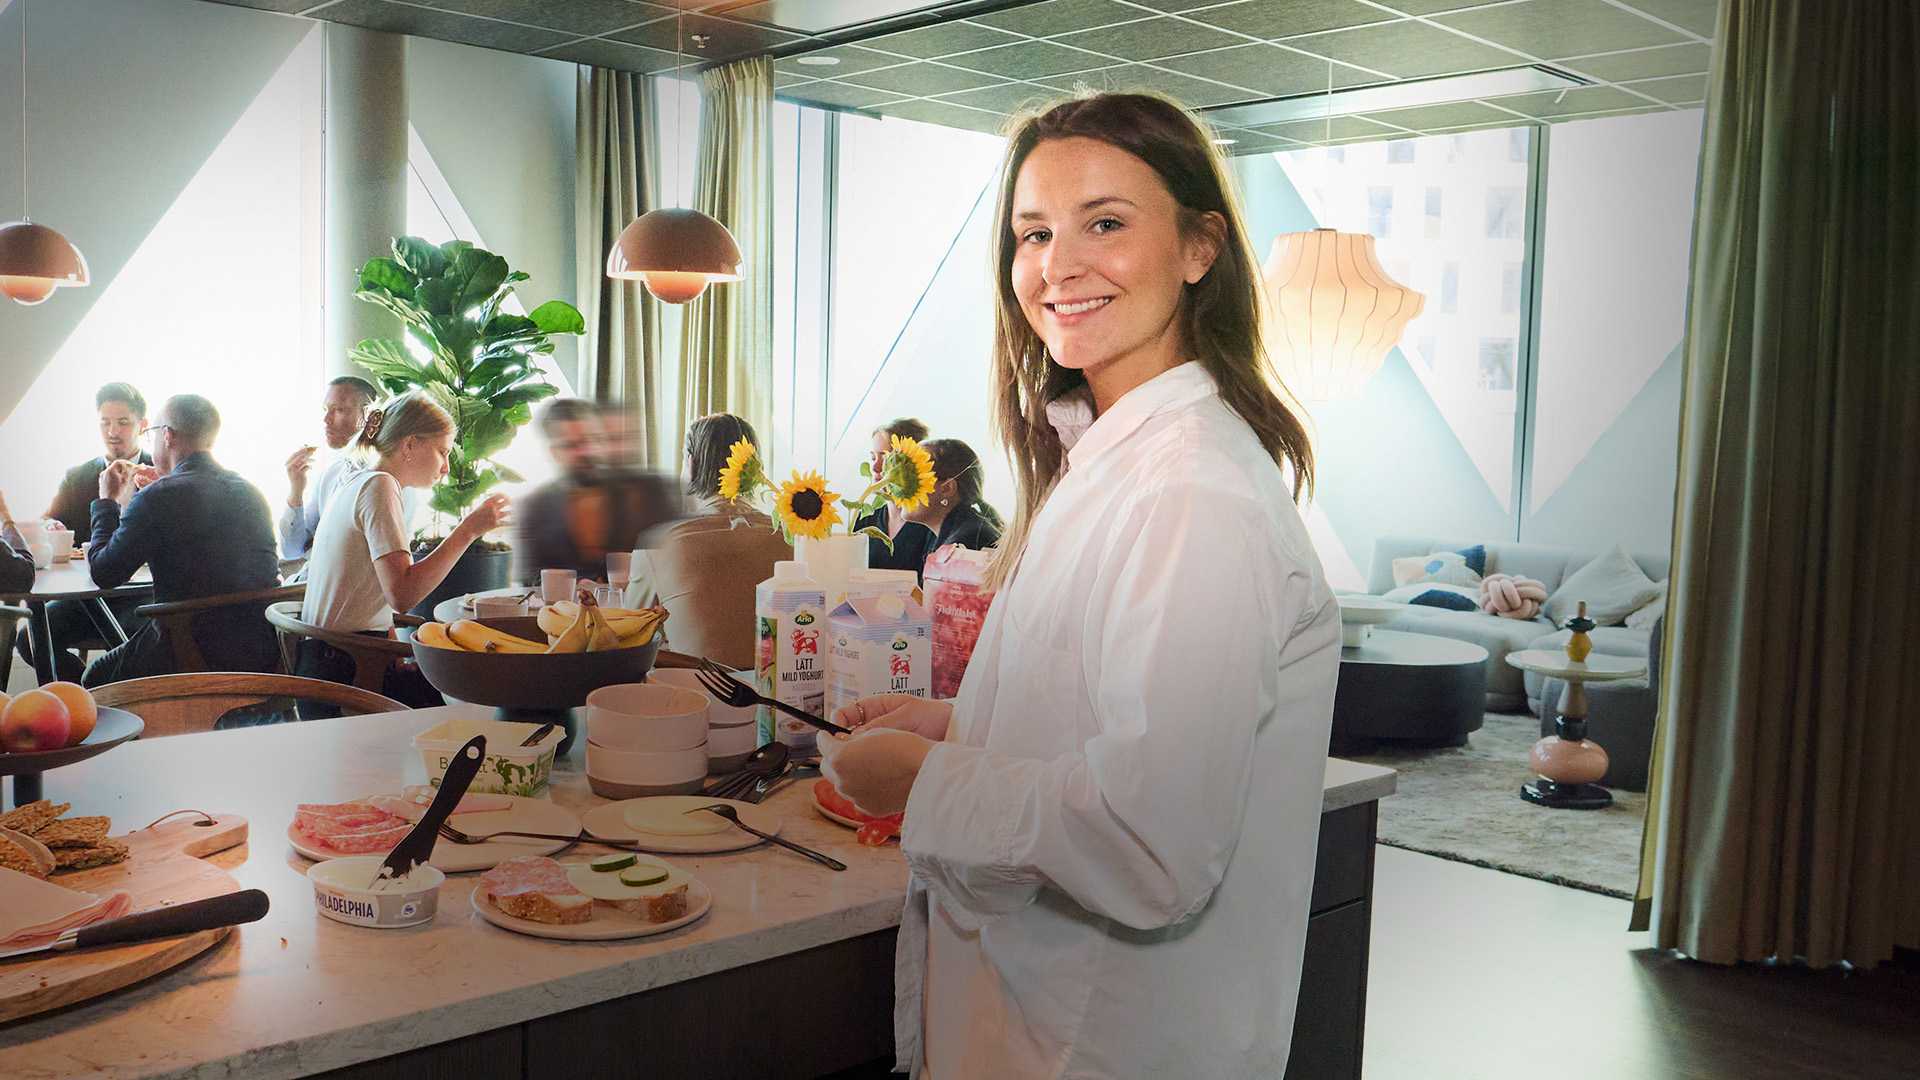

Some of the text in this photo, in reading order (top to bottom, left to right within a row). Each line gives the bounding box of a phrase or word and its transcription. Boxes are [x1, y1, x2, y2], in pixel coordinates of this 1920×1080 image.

[797, 615, 812, 623] Arla
[894, 641, 906, 649] Arla
[795, 658, 814, 671] LÄTT
[782, 671, 798, 682] MILD
[799, 670, 824, 681] YOGHURT
[891, 677, 909, 690] LÄTT
